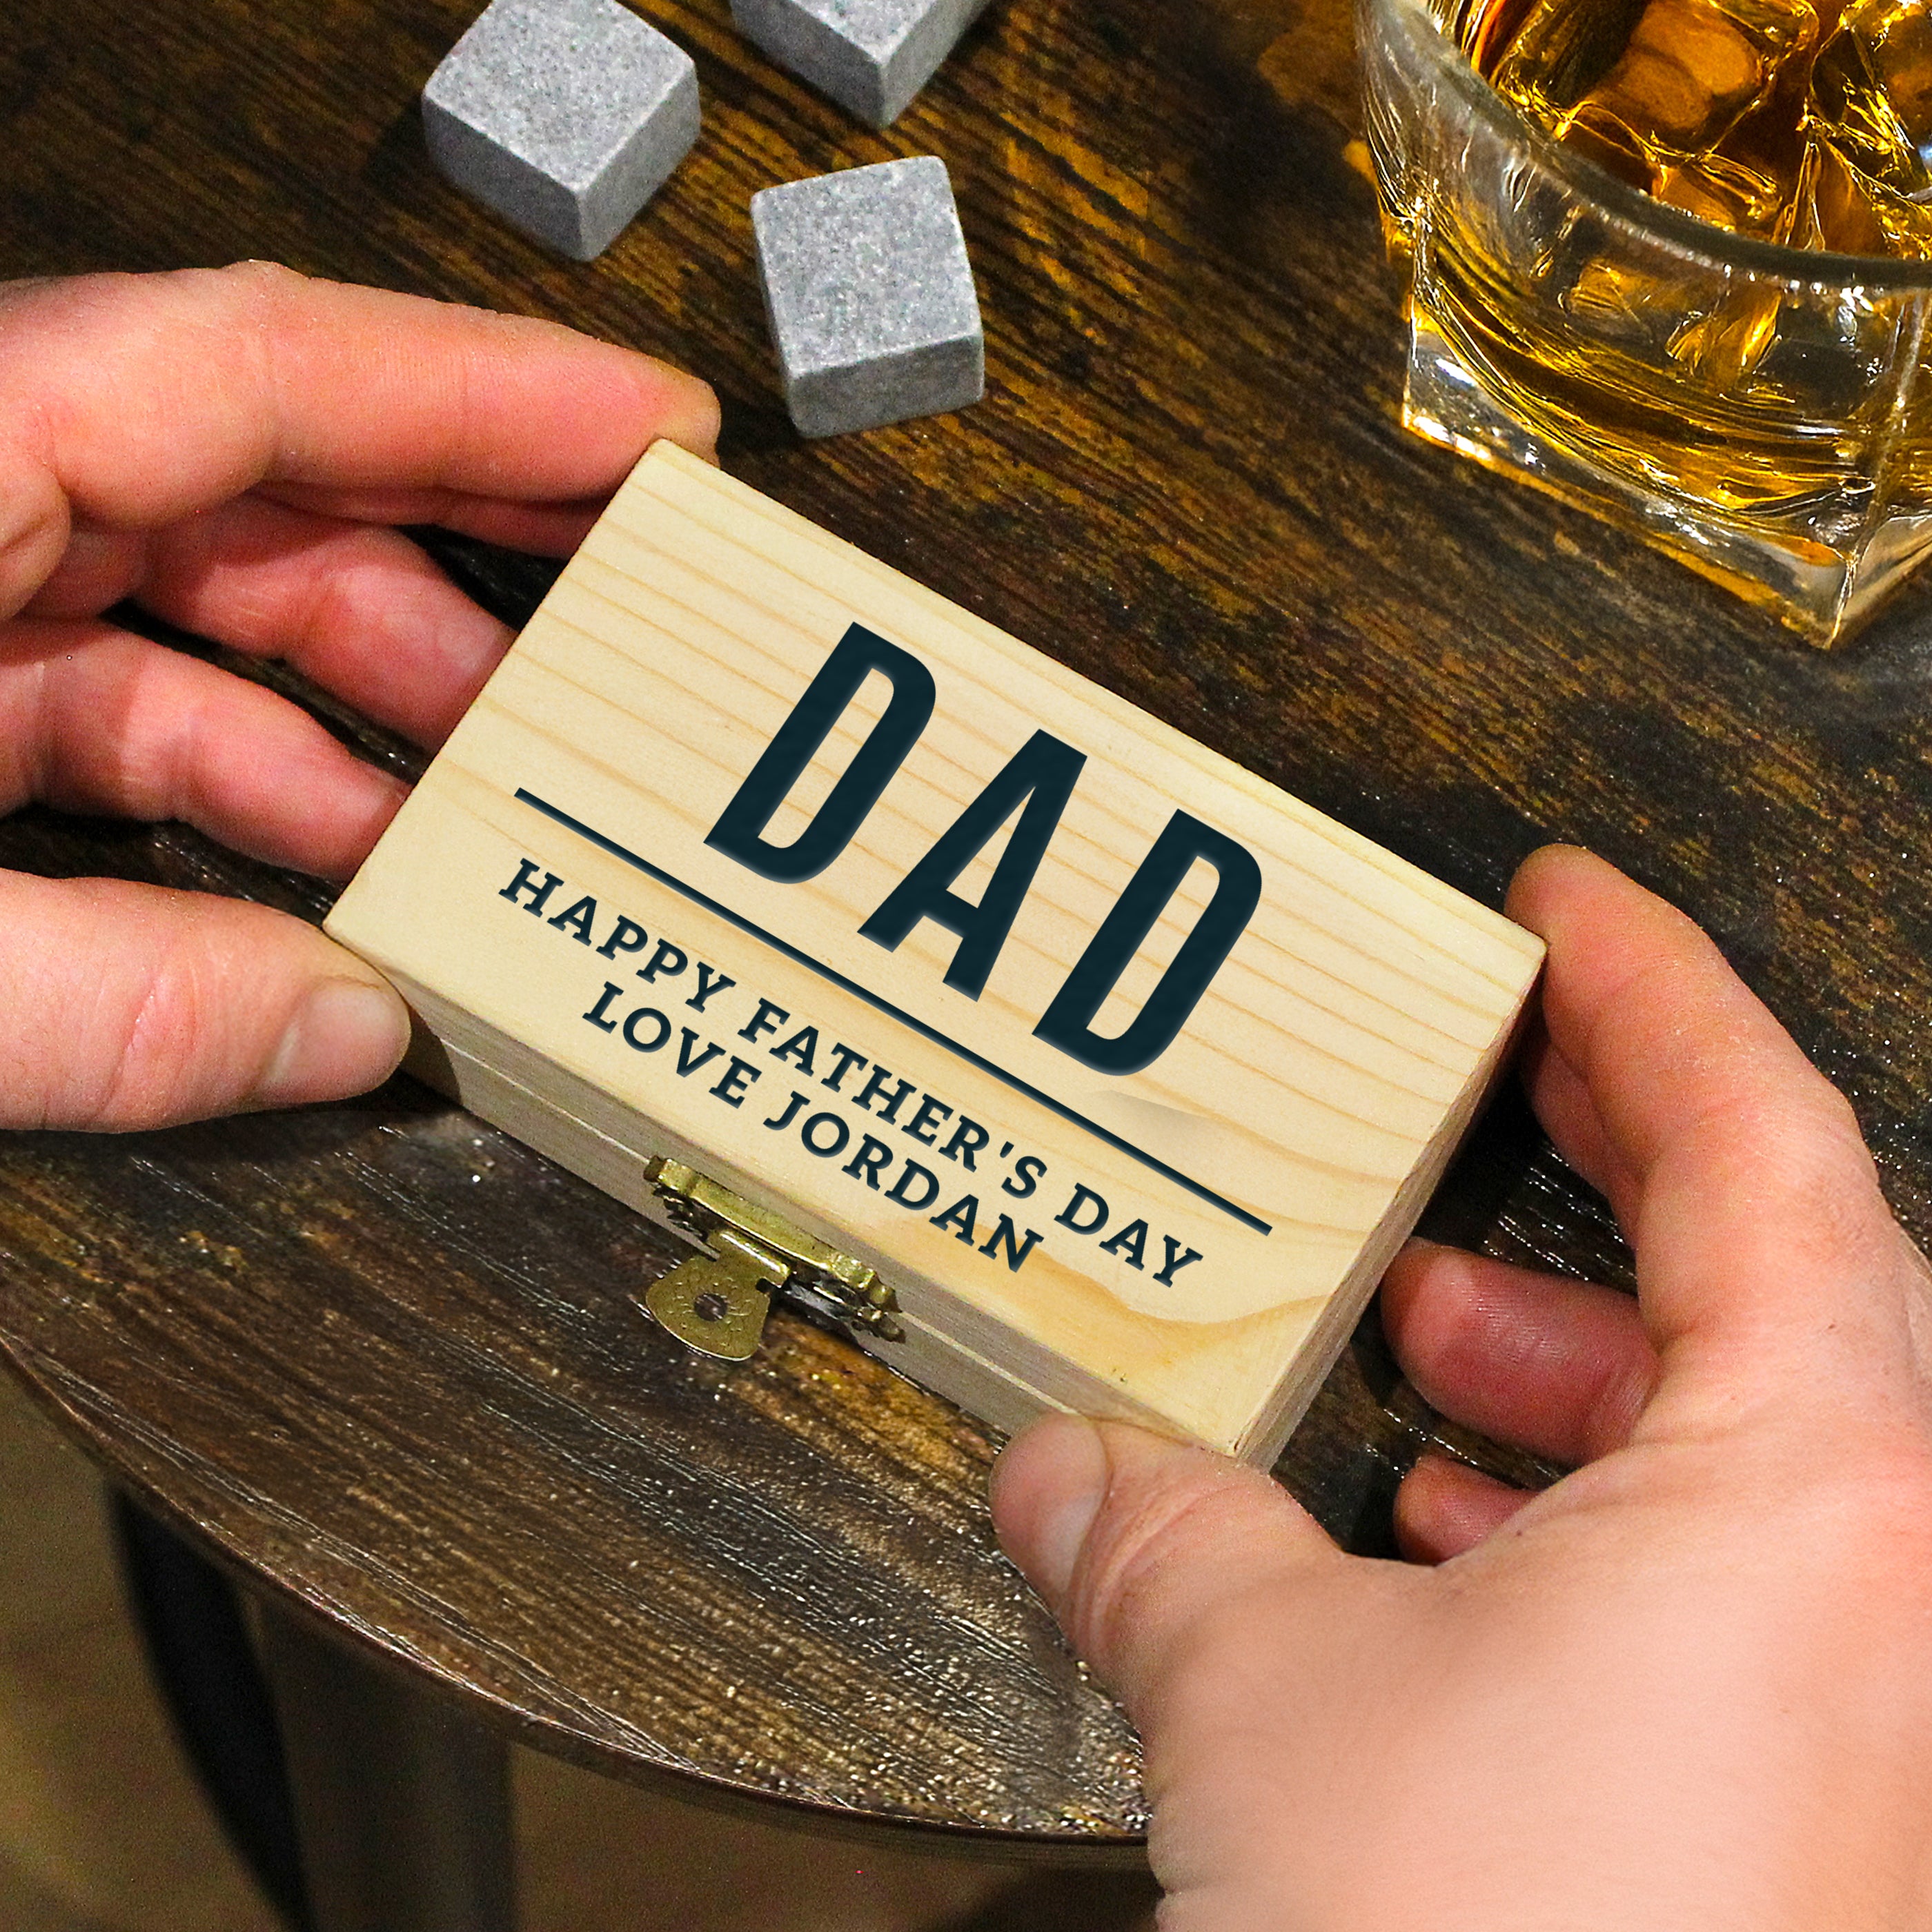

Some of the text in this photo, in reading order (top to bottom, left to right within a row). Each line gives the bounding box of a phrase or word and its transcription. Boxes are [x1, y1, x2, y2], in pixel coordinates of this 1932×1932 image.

[702, 621, 1263, 1076] DAD
[498, 858, 1204, 1288] HAPPY FATHER'S DAY
[582, 980, 1045, 1273] LOVE JORDAN
